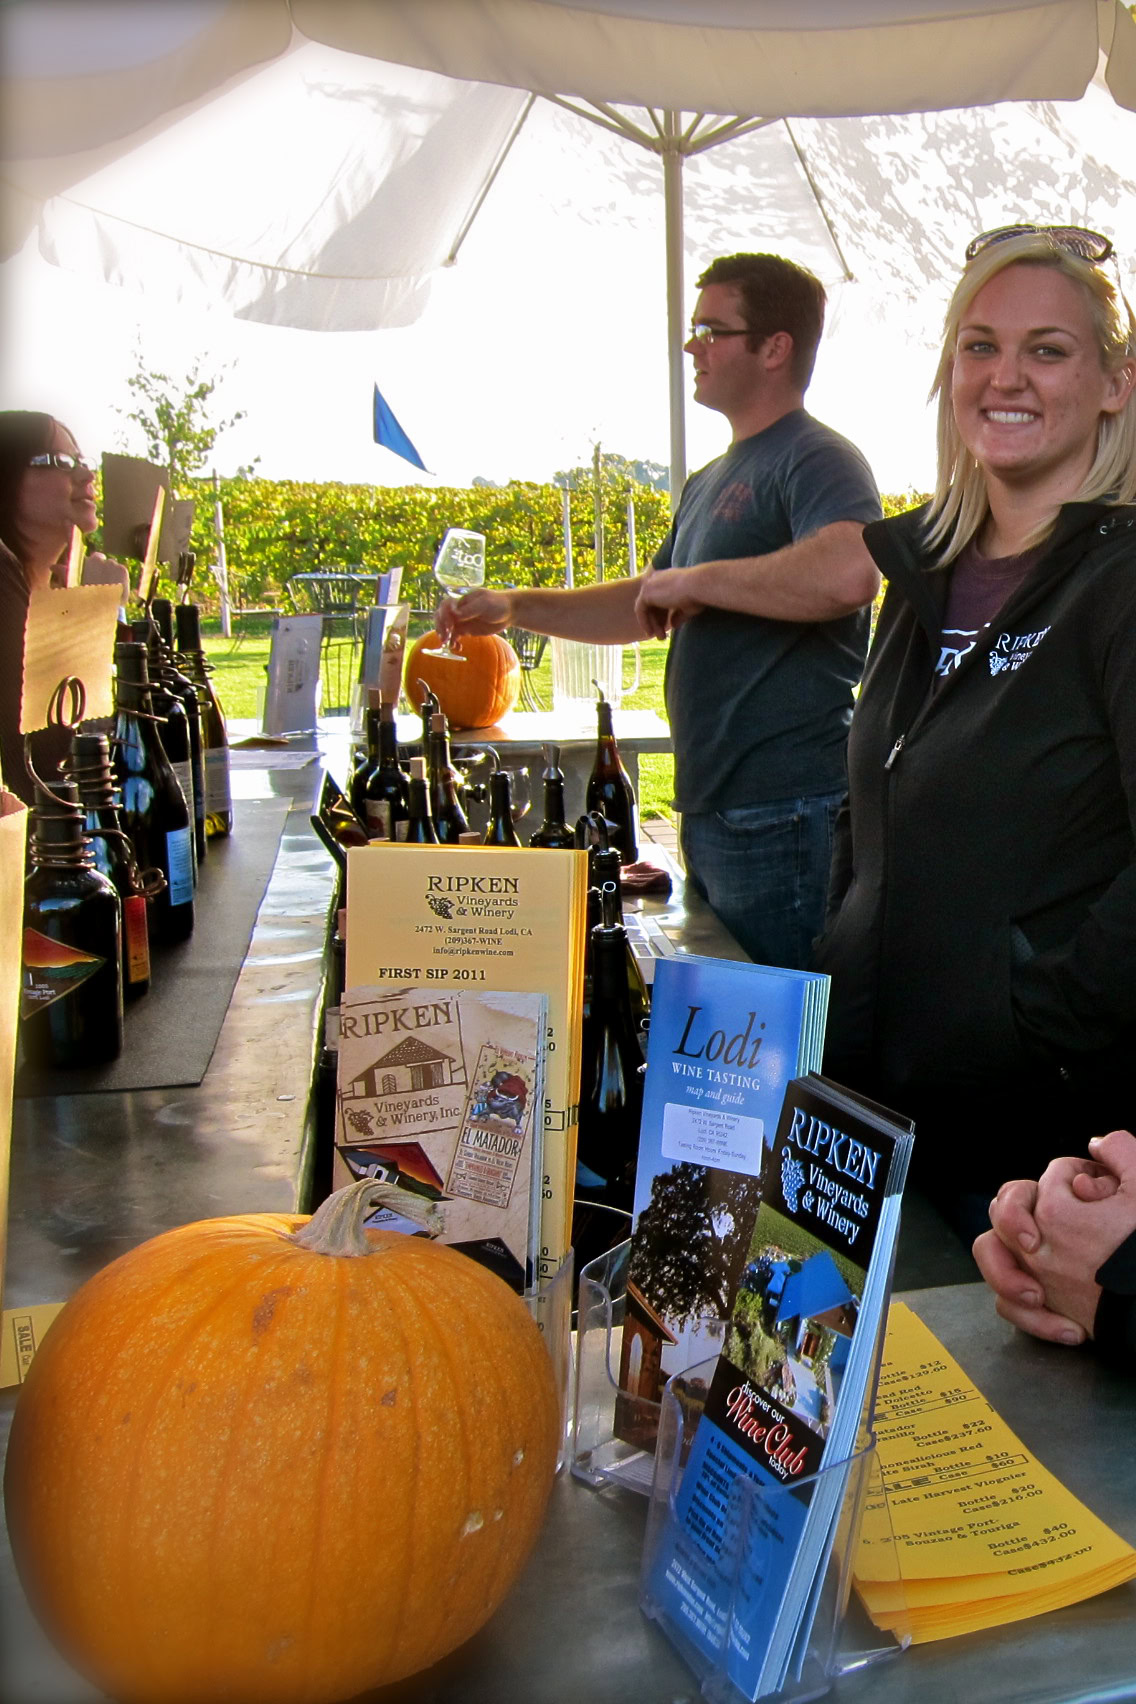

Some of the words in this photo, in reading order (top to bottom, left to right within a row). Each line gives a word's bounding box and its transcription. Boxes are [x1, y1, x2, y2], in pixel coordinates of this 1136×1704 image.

[427, 876, 519, 893] RIPKEN
[456, 896, 519, 908] Vineyards
[456, 907, 468, 916] &
[471, 907, 515, 919] Winery
[448, 926, 476, 935] Sargent
[478, 927, 498, 935] Road
[500, 928, 519, 936] Lodi,
[445, 937, 503, 945] (209)367-WINE
[379, 968, 421, 979] FIRST
[426, 969, 448, 979] SIP
[453, 970, 486, 980] 2011
[341, 1002, 454, 1039] RIPKEN
[672, 1005, 766, 1069] Lodi
[672, 1062, 703, 1079] WINE
[707, 1069, 761, 1091] TASTING
[686, 1084, 701, 1100] map
[705, 1087, 721, 1100] and
[721, 1090, 745, 1105] guide
[374, 1094, 440, 1114] Vineyards
[376, 1115, 388, 1127] &
[390, 1110, 438, 1126] Winery,
[461, 1126, 472, 1145] EL
[473, 1129, 519, 1157] MATADOR
[787, 1106, 882, 1190] RIPKEN
[809, 1163, 869, 1219] Vineyards
[802, 1190, 814, 1212] &
[816, 1196, 860, 1245] Winery
[18, 1325, 32, 1352] SALE
[920, 1360, 941, 1369] $12
[880, 1370, 906, 1380] ottle
[884, 1390, 933, 1405] Dolcetto
[900, 1385, 921, 1395] Red
[741, 1380, 771, 1412] discover
[771, 1409, 785, 1423] our
[892, 1399, 926, 1410] Bottle
[940, 1388, 962, 1397] $15
[895, 1407, 923, 1416] Case
[944, 1394, 967, 1404] $90
[726, 1386, 766, 1443] Wine
[765, 1423, 808, 1475] Club
[873, 1423, 916, 1436] atador
[962, 1419, 985, 1429] $22
[912, 1429, 949, 1442] Bottle
[959, 1442, 984, 1453] Red
[768, 1455, 789, 1480] today
[902, 1461, 935, 1473] Sirah
[933, 1460, 972, 1473] Bottle
[985, 1451, 1009, 1461] $10
[939, 1470, 968, 1481] Case
[991, 1459, 1015, 1469] $60
[892, 1496, 920, 1506] Late
[923, 1484, 972, 1500] Harvest
[974, 1471, 1027, 1488] Viognier
[1011, 1484, 1036, 1494] $20
[957, 1494, 996, 1508] Bottle
[905, 1535, 953, 1547] Souzao
[956, 1532, 968, 1540] &
[971, 1520, 1020, 1538] Touriga
[913, 1525, 964, 1539] Vintage
[1043, 1522, 1068, 1535] $40
[987, 1536, 1028, 1550] Bottle
